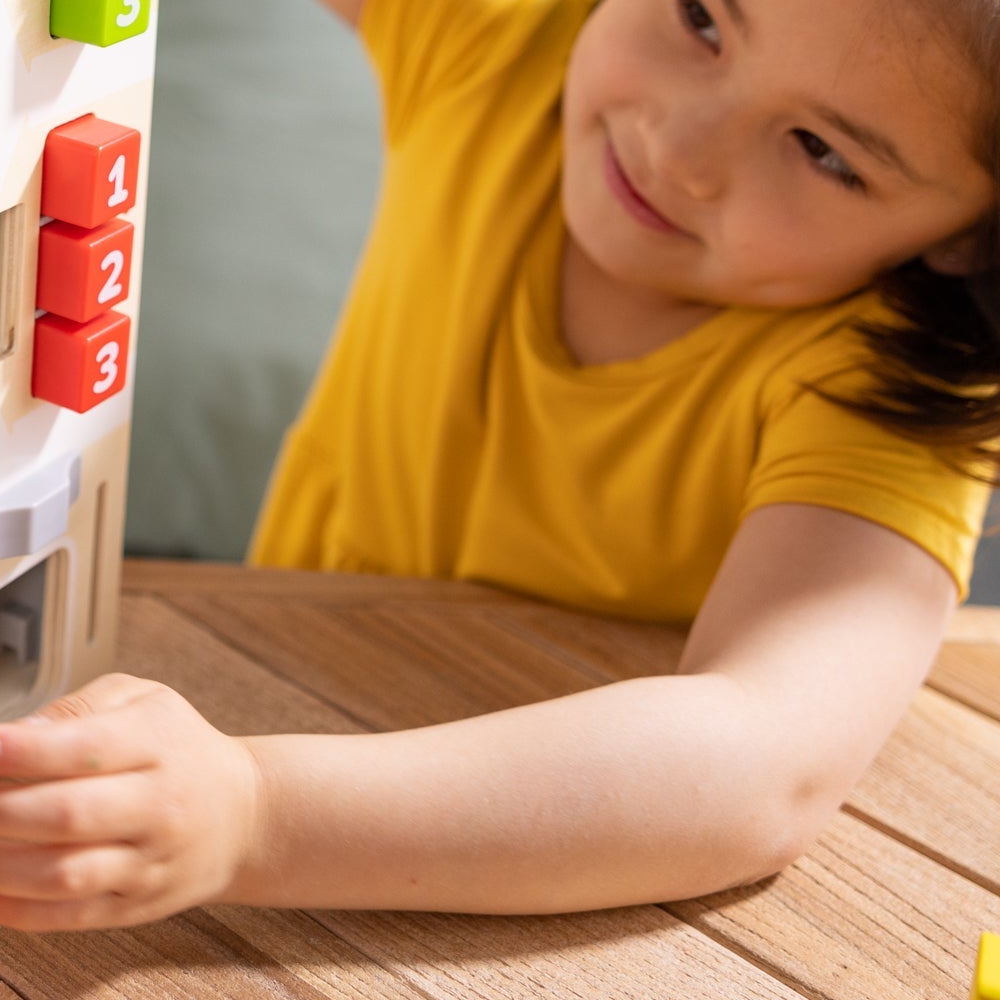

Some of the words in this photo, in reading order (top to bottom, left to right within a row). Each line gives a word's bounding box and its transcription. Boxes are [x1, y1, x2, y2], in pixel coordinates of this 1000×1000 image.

[107, 154, 129, 208] 1
[97, 249, 125, 305] 2
[92, 340, 120, 395] 3
